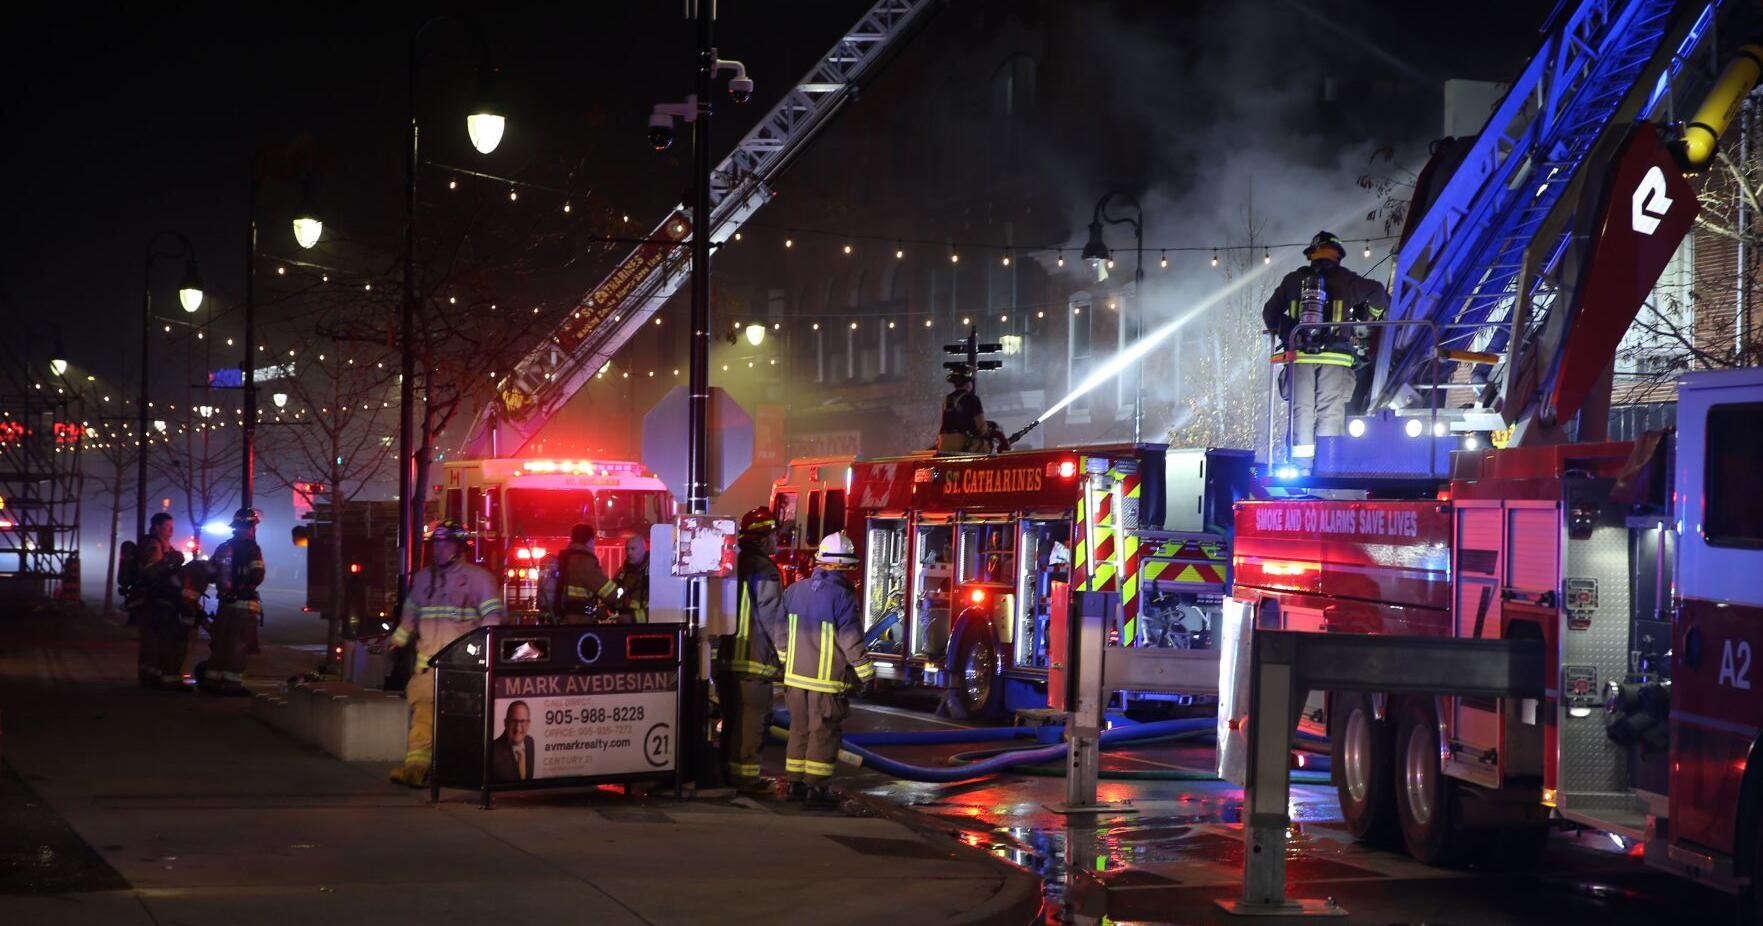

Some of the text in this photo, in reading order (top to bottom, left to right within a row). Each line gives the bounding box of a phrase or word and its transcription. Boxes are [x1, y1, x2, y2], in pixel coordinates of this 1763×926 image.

[944, 468, 1042, 494] ST. CATHARINES
[1256, 508, 1418, 537] SMOKE AND CO ALARMS SAVE LIVES
[1718, 639, 1751, 690] A2
[505, 672, 668, 696] MARK AVEDESIAN
[545, 706, 645, 726] 905-988-8228
[544, 738, 631, 752] avmarkrealty.com
[653, 735, 669, 756] 21
